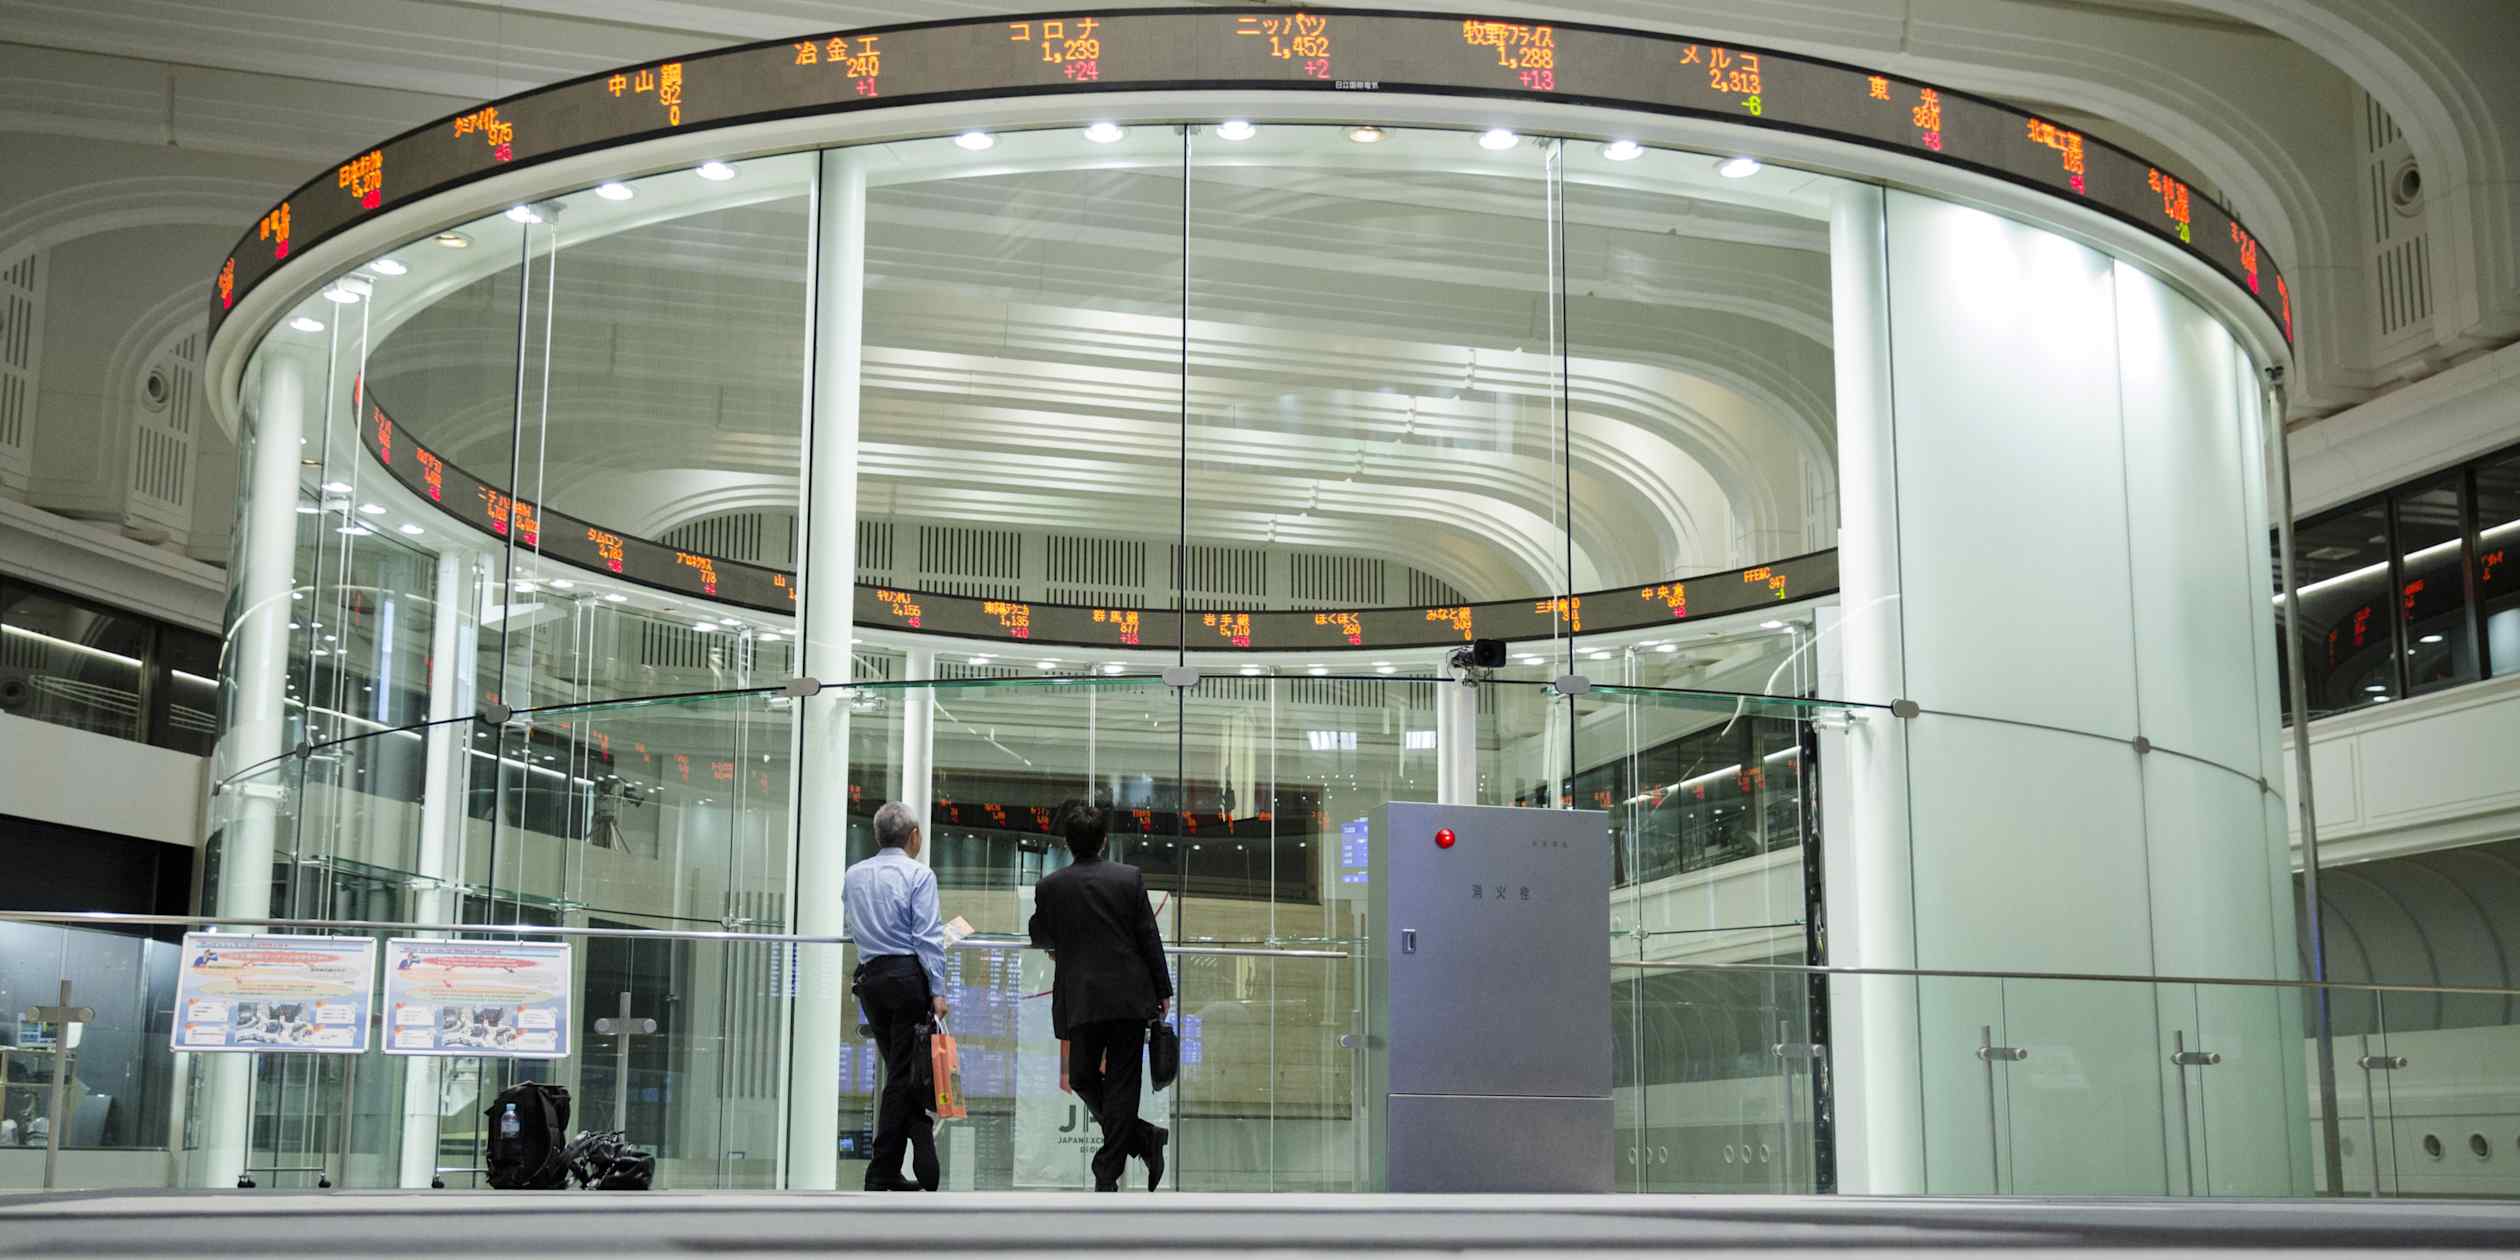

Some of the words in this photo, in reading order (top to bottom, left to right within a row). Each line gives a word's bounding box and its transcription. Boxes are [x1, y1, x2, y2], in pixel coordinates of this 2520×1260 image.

[1008, 16, 1100, 41] コロナ
[1234, 12, 1327, 37] ニッパツ
[1462, 19, 1554, 47] 牧野フライス
[794, 35, 881, 66] 冶金工
[1040, 39, 1101, 64] 1,239
[1269, 36, 1331, 60] 1,452
[1497, 46, 1554, 70] 1,288
[1679, 43, 1760, 75] メルコ
[846, 56, 880, 79] 240
[1063, 60, 1099, 82] +24
[1304, 59, 1331, 80] +2
[608, 62, 683, 98] 中山鋼
[855, 77, 879, 98] +1
[1519, 69, 1555, 91] +13
[1710, 69, 1761, 95] 2,313
[660, 86, 682, 108] 92
[1740, 94, 1762, 117] -6
[1867, 75, 1941, 113] 東光
[669, 104, 681, 127] 0
[1314, 612, 1360, 625] ほくほく
[1463, 629, 1473, 641] 0
[1057, 1136, 1084, 1144] JAPAN
